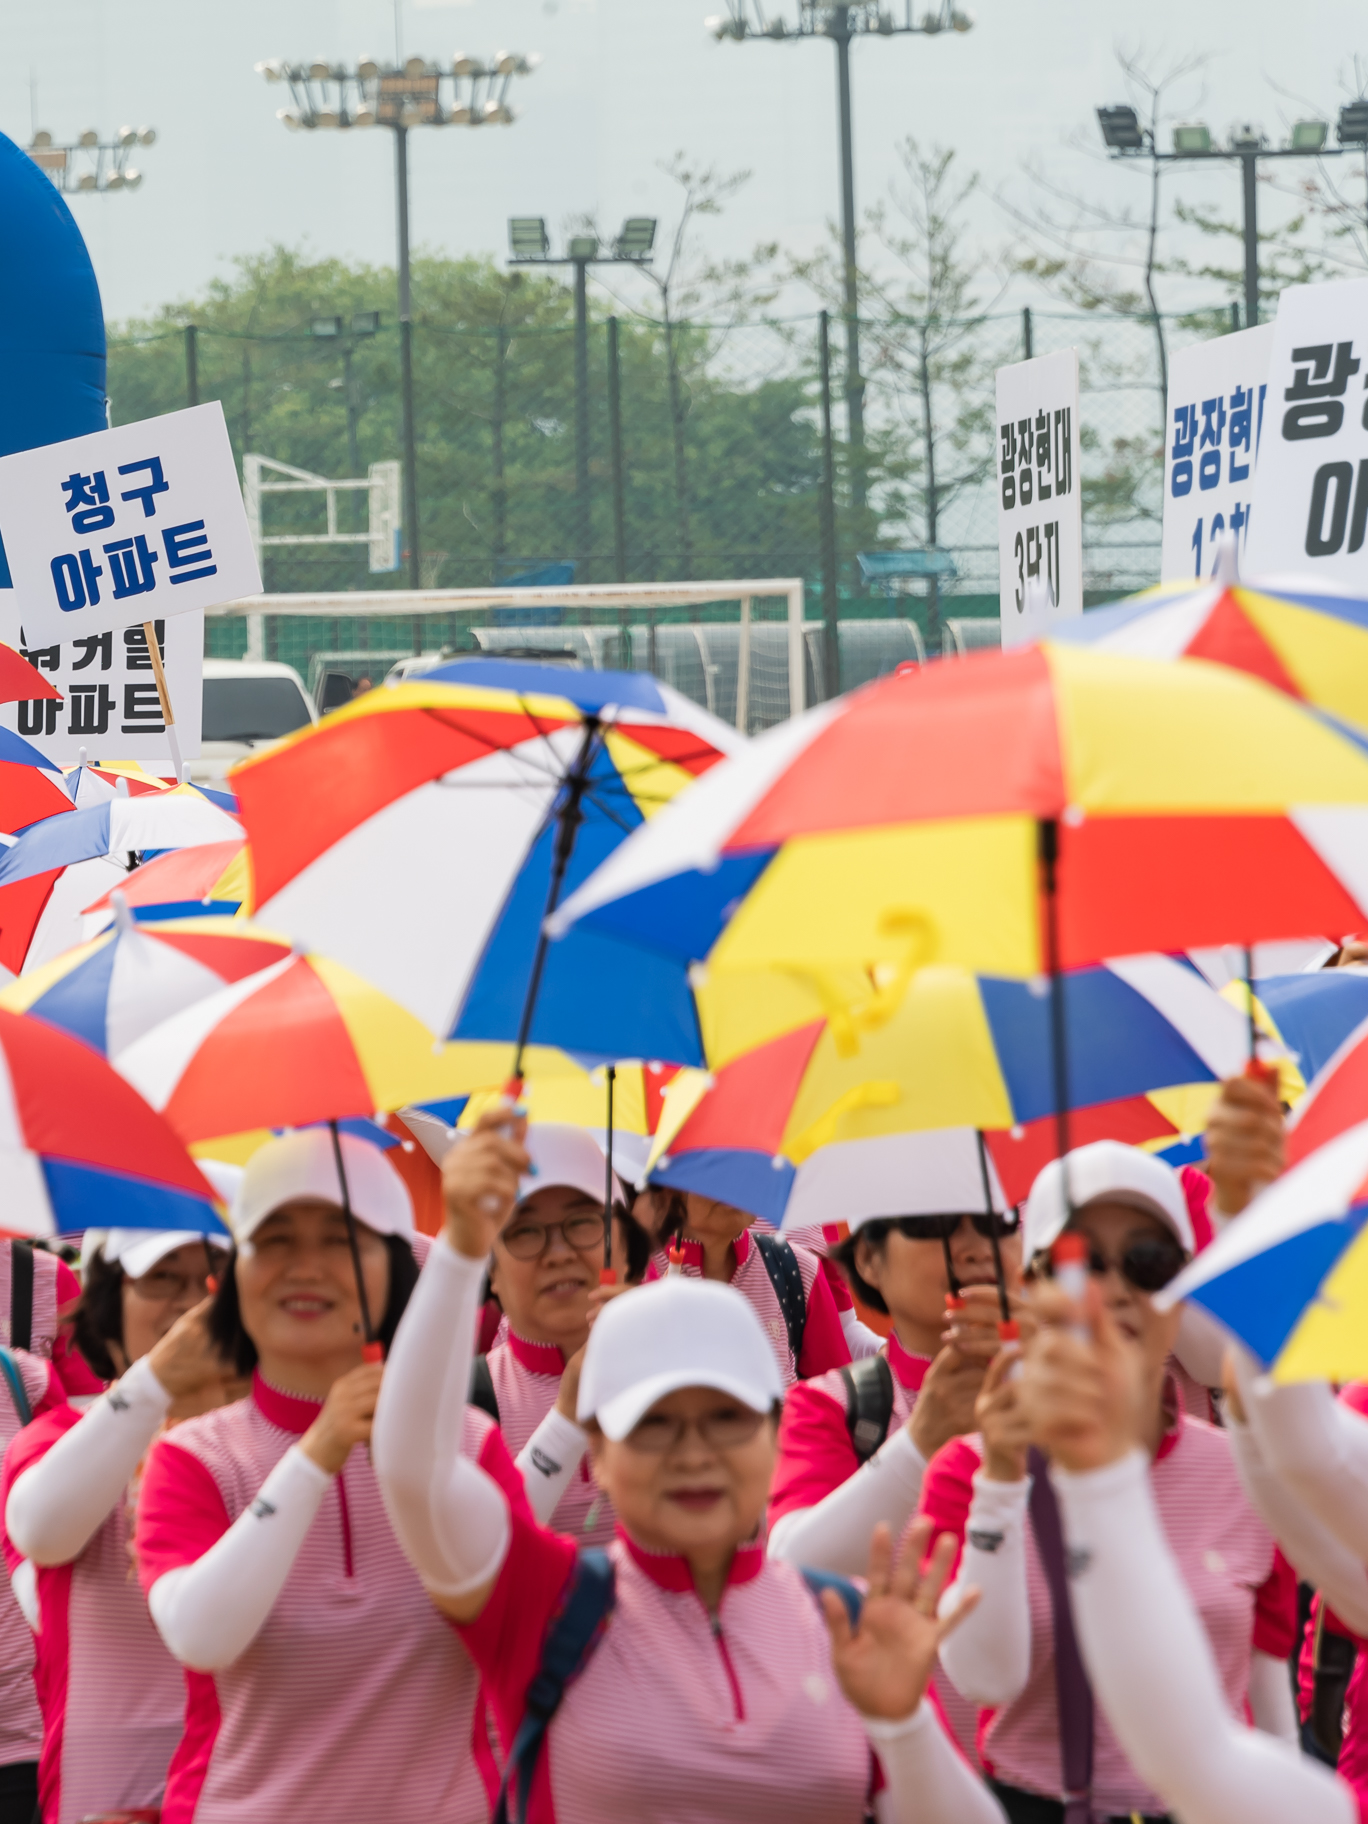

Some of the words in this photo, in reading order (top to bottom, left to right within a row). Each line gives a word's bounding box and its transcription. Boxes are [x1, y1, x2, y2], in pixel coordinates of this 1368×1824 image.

[1282, 340, 1368, 442] 광
[1000, 407, 1072, 511] 광장현대
[1171, 384, 1268, 498] 광장현
[60, 456, 170, 535] 청구
[50, 519, 218, 613] 아파트
[17, 683, 167, 736] 아파트
